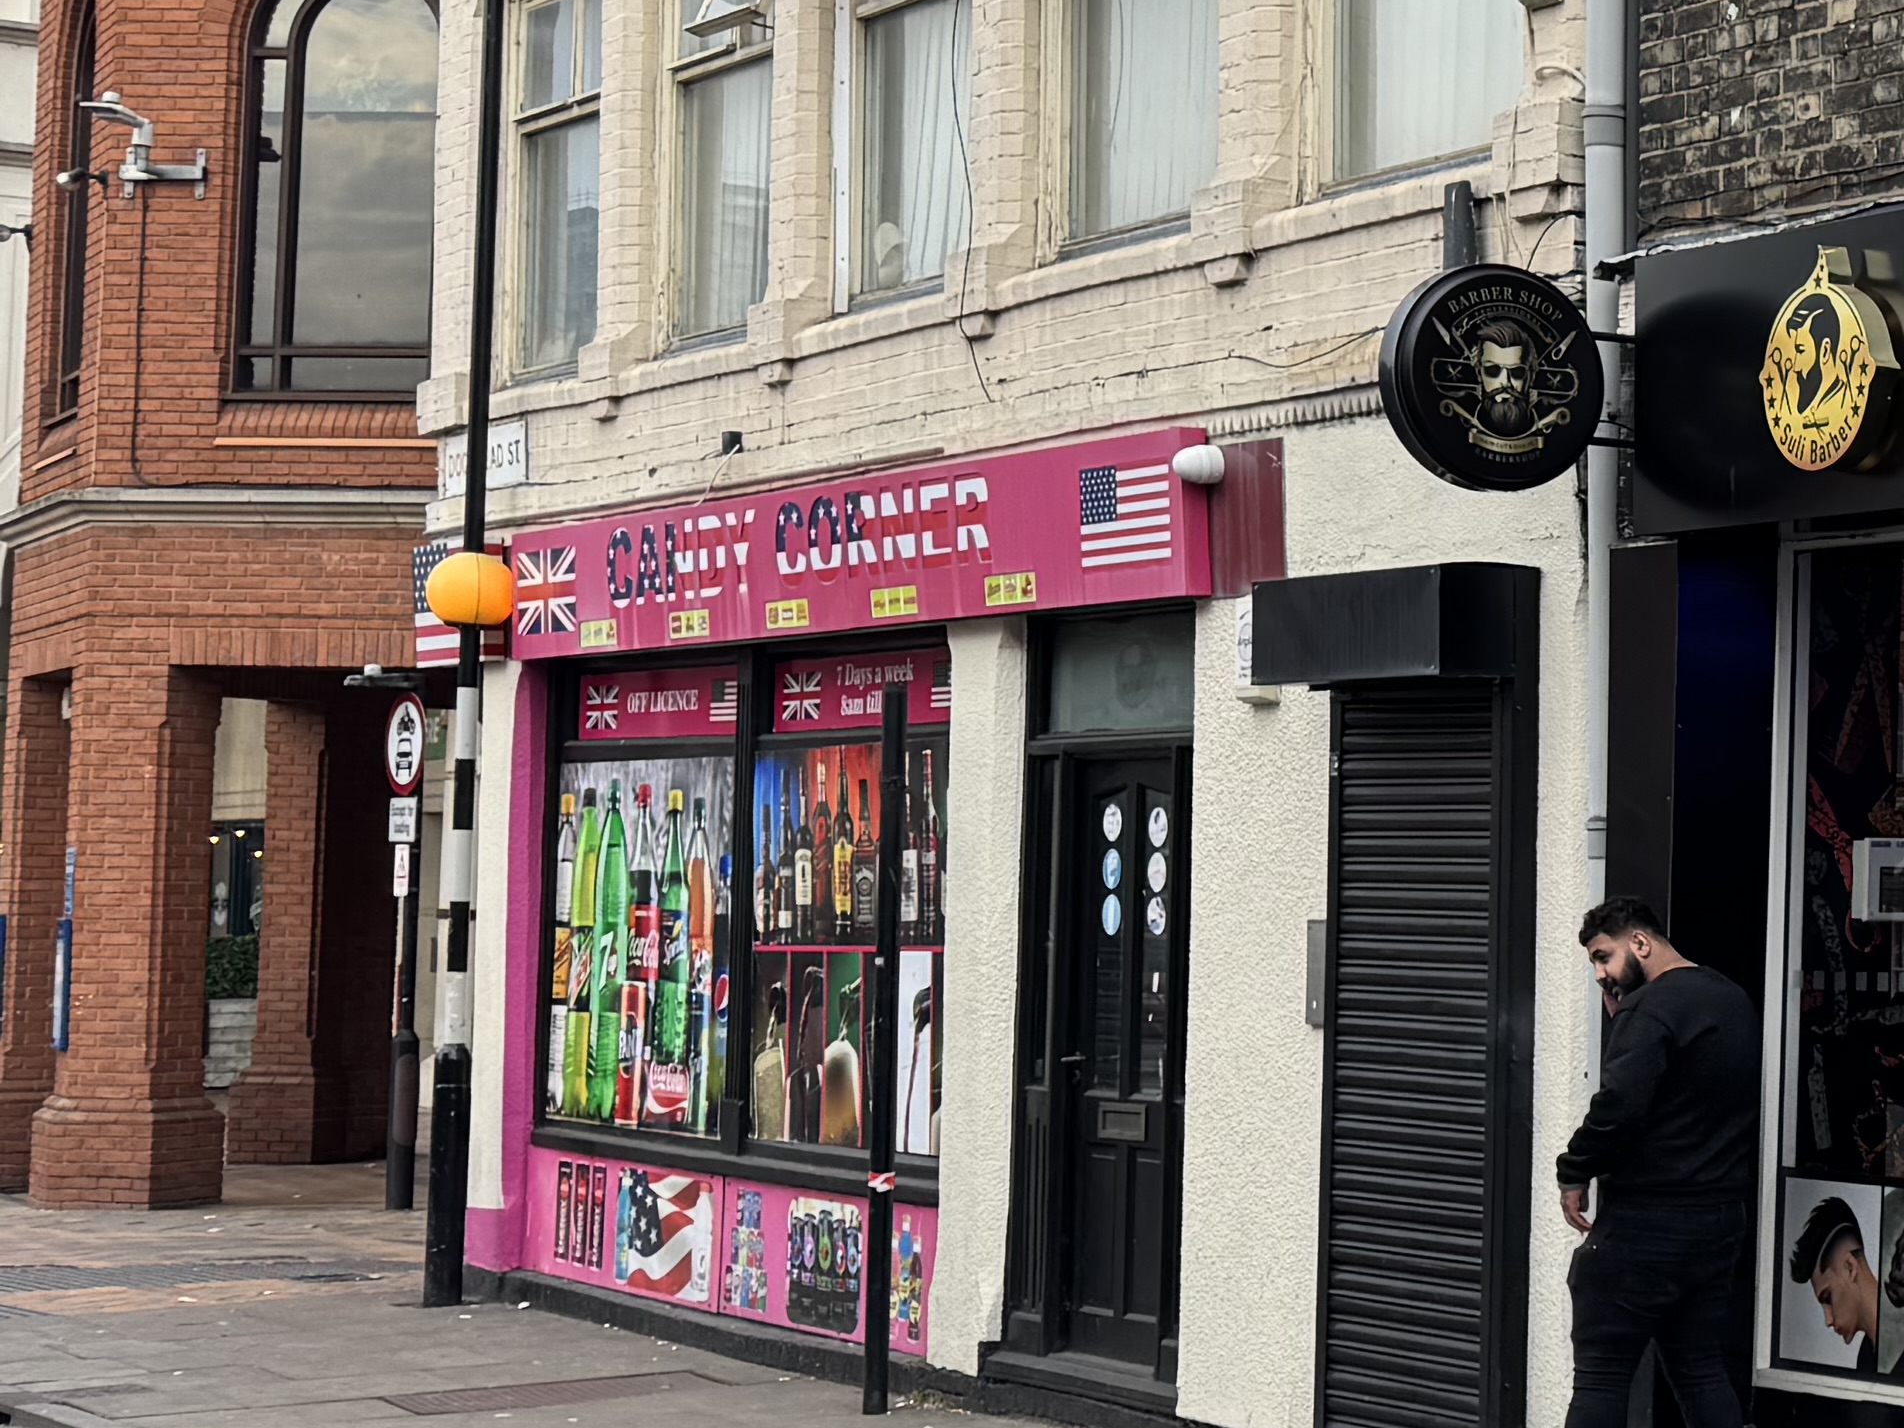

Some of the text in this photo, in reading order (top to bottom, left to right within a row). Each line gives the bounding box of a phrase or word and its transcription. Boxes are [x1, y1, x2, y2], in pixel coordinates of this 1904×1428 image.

[1447, 286, 1564, 322] BARBER SHOP
[1779, 415, 1853, 464] Suli Barber
[607, 475, 992, 609] CANDY CORNER
[836, 665, 843, 686] 7
[844, 663, 873, 691] Days
[884, 658, 914, 684] week
[627, 689, 699, 714] OFF LICENCE
[840, 691, 882, 717] 8am till
